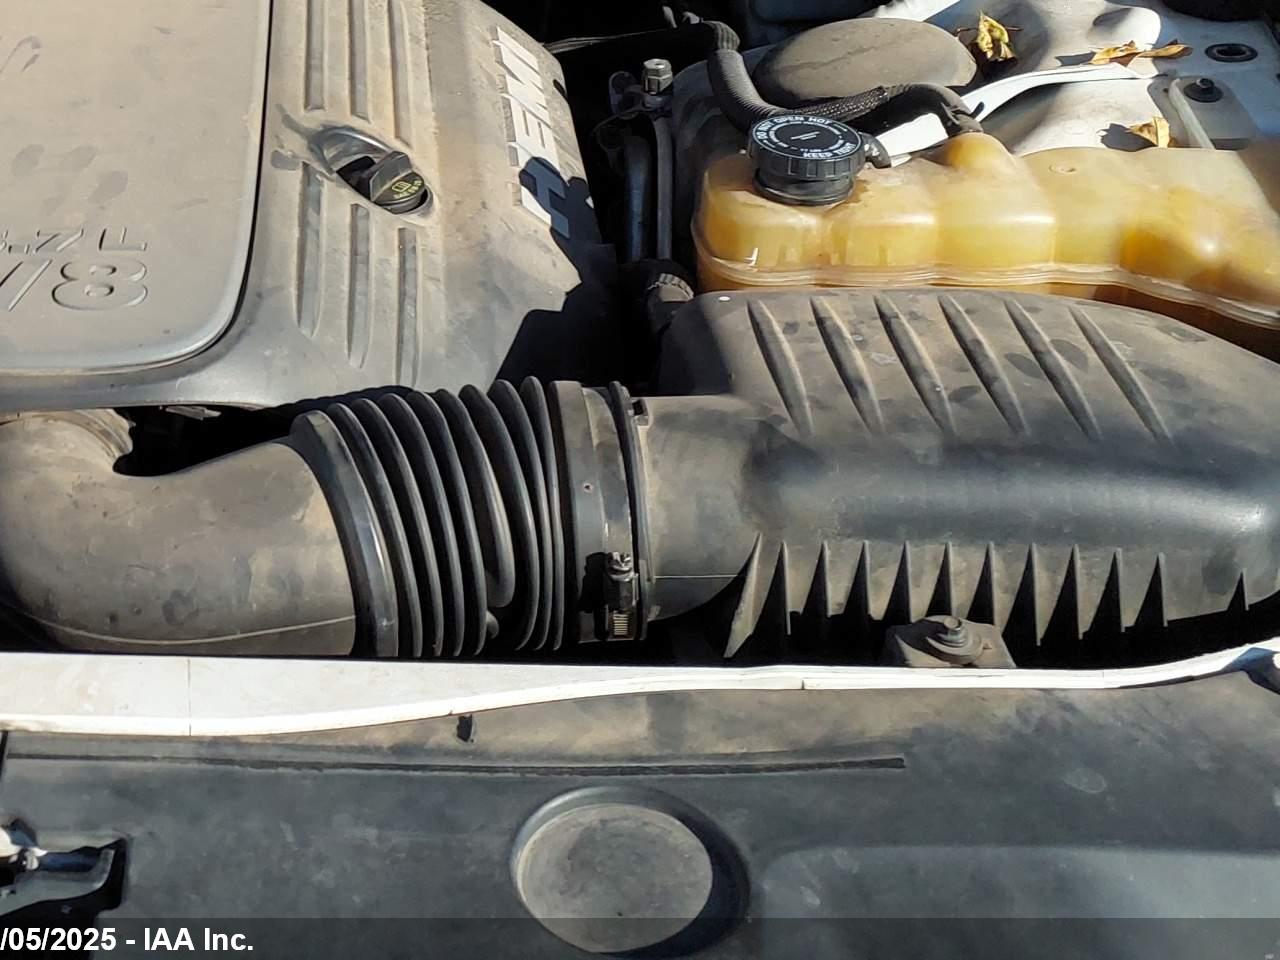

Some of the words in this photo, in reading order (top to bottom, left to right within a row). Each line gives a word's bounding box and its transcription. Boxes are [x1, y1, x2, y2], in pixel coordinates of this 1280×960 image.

[494, 26, 570, 239] HEMI
[773, 116, 805, 124] OPEN
[808, 116, 833, 125] HOT
